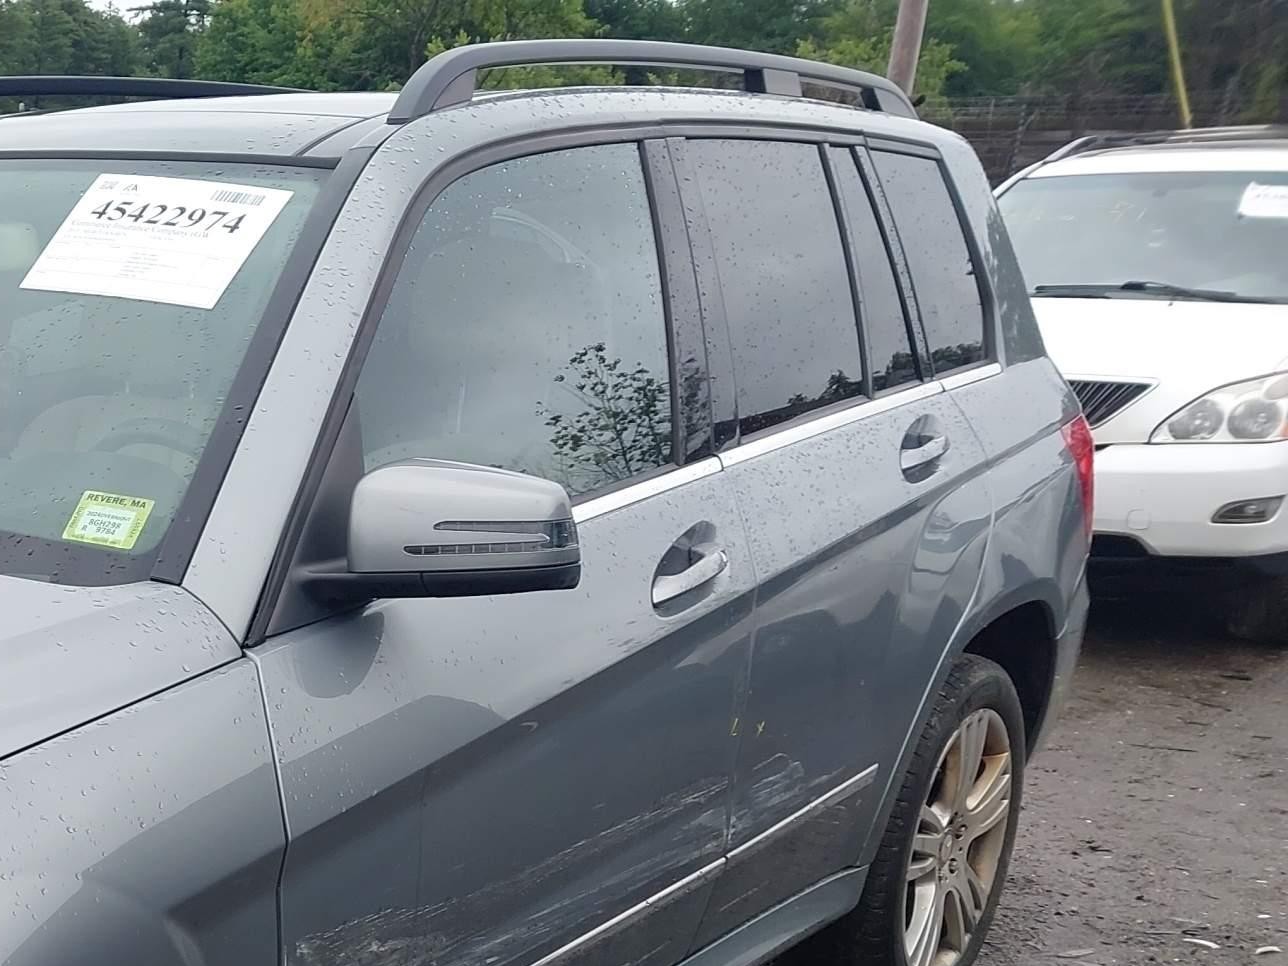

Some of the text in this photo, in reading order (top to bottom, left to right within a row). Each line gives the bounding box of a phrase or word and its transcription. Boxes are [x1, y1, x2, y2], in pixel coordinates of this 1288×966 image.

[91, 199, 246, 234] 45422974
[86, 493, 146, 509] REVERE, MA
